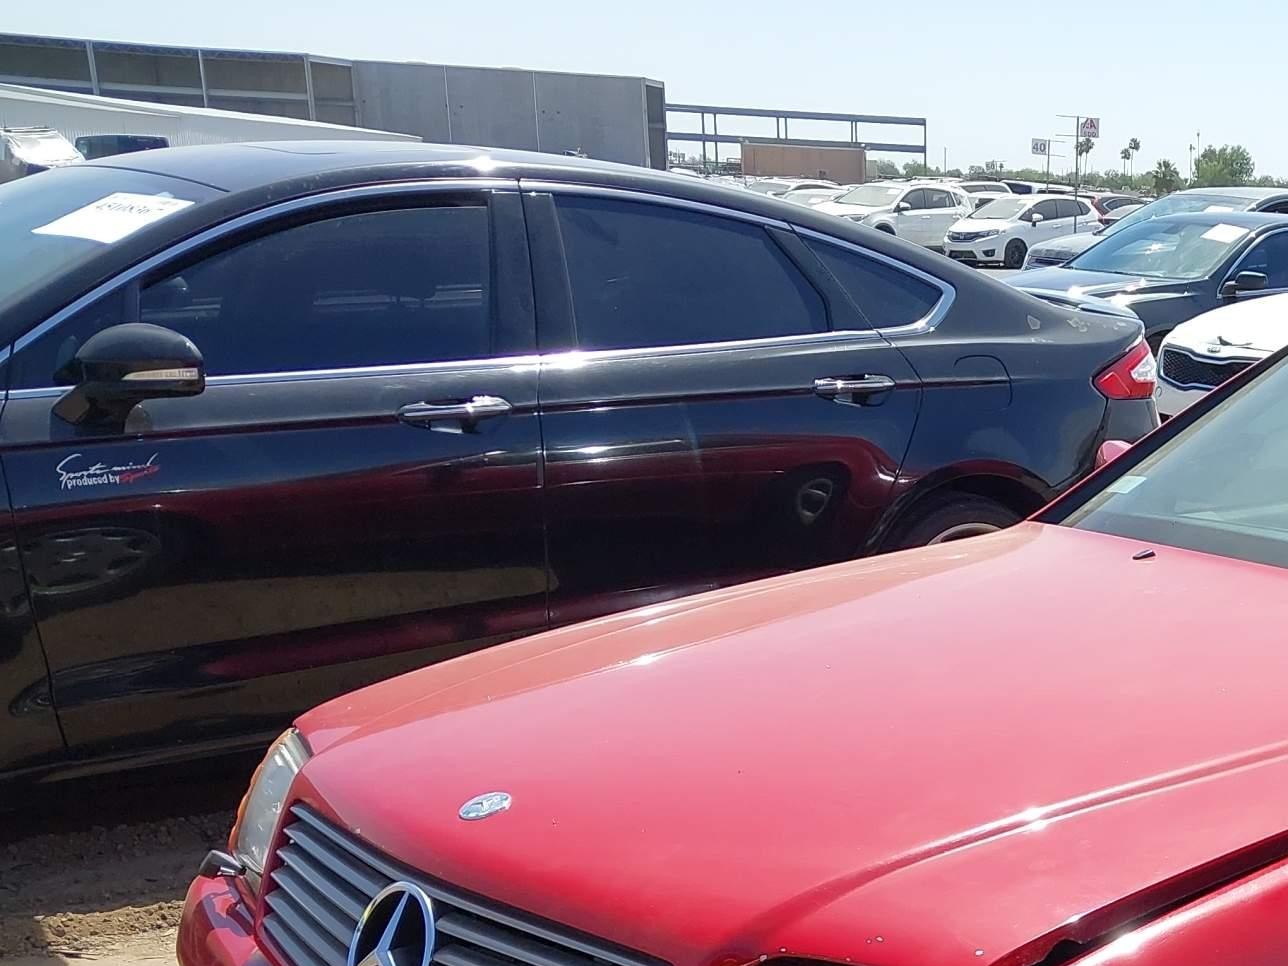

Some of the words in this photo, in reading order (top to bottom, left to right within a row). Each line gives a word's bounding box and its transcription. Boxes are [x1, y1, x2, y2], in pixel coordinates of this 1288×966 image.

[1032, 142, 1046, 152] 40
[66, 474, 108, 490] produced
[109, 473, 120, 484] by
